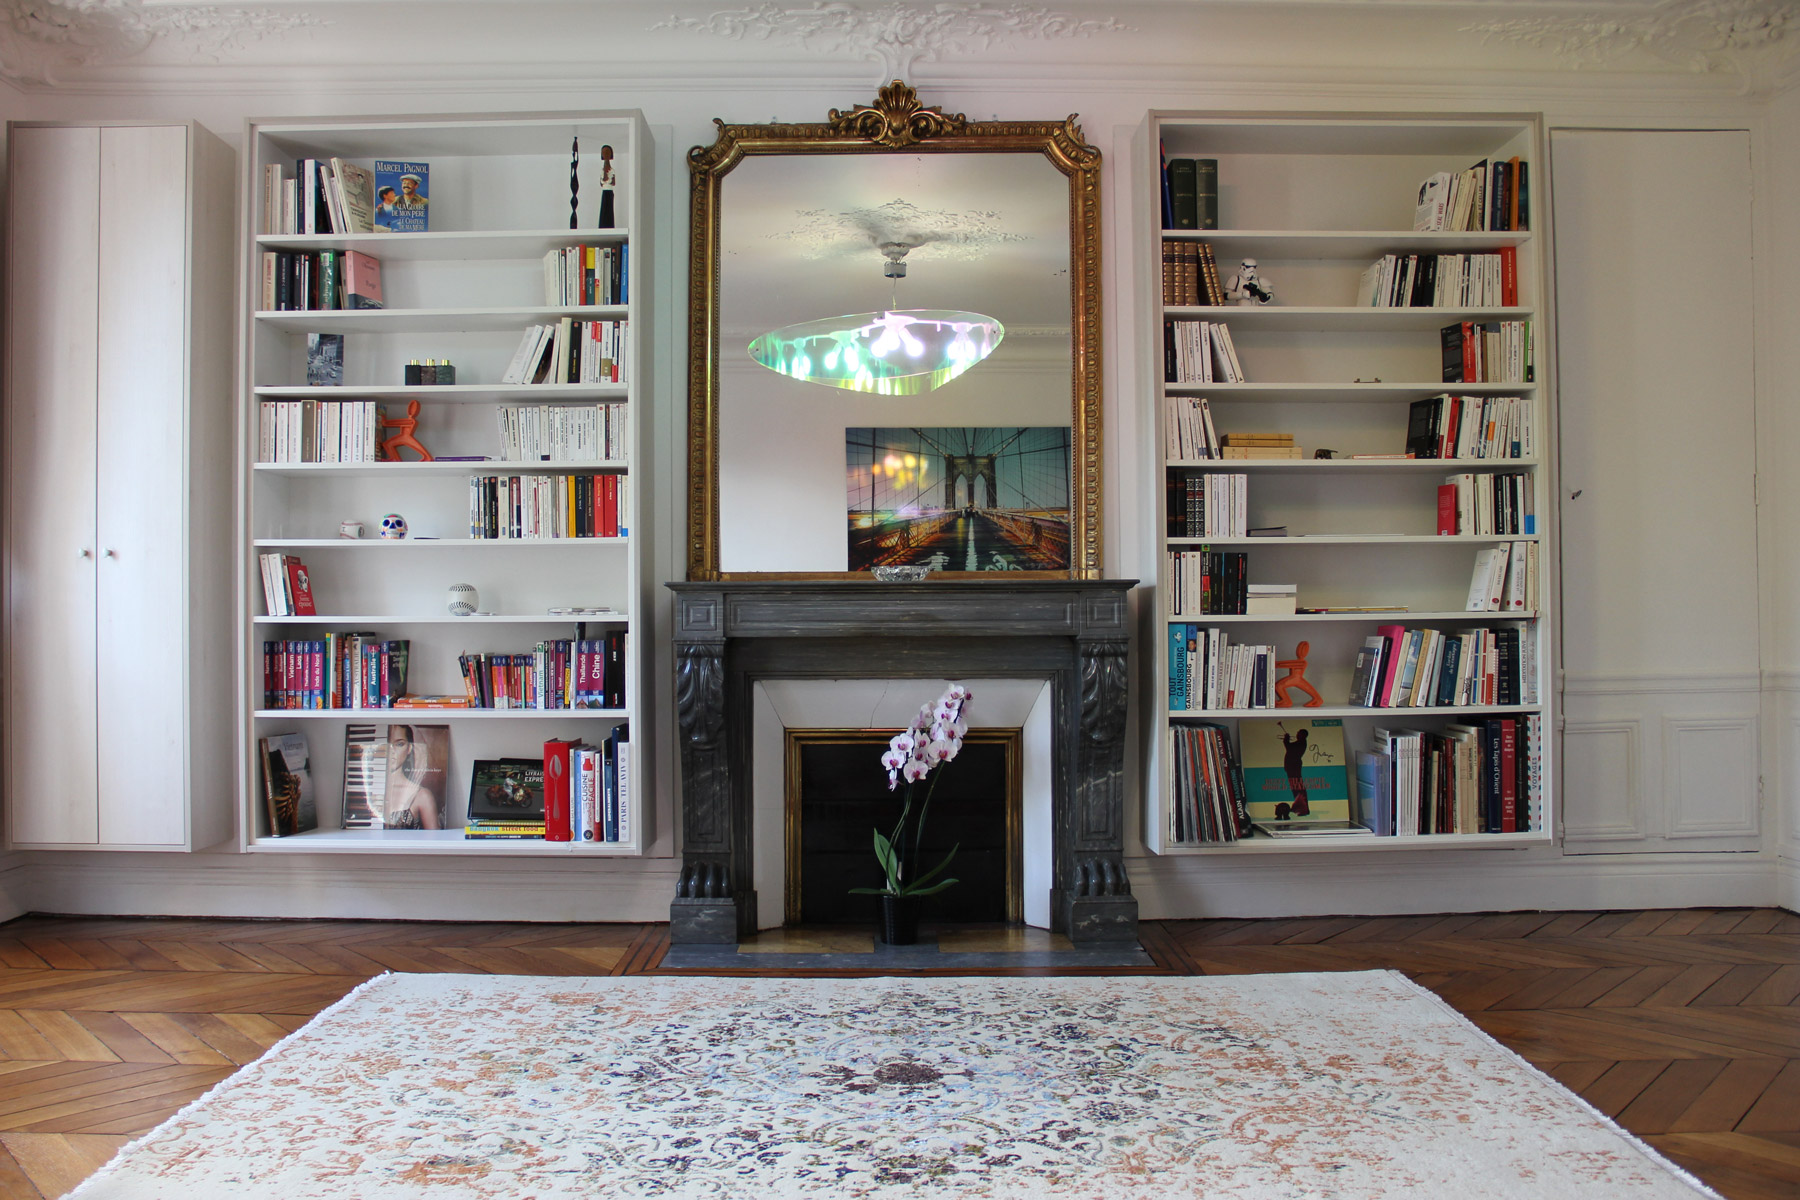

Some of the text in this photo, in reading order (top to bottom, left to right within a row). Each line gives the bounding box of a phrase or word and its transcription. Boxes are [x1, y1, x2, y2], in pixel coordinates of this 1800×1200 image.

[376, 161, 428, 173] MARCEL PAGNOL
[592, 654, 600, 679] Chine
[1230, 769, 1241, 799] BASHUNG
[1236, 800, 1244, 820] ALAIN
